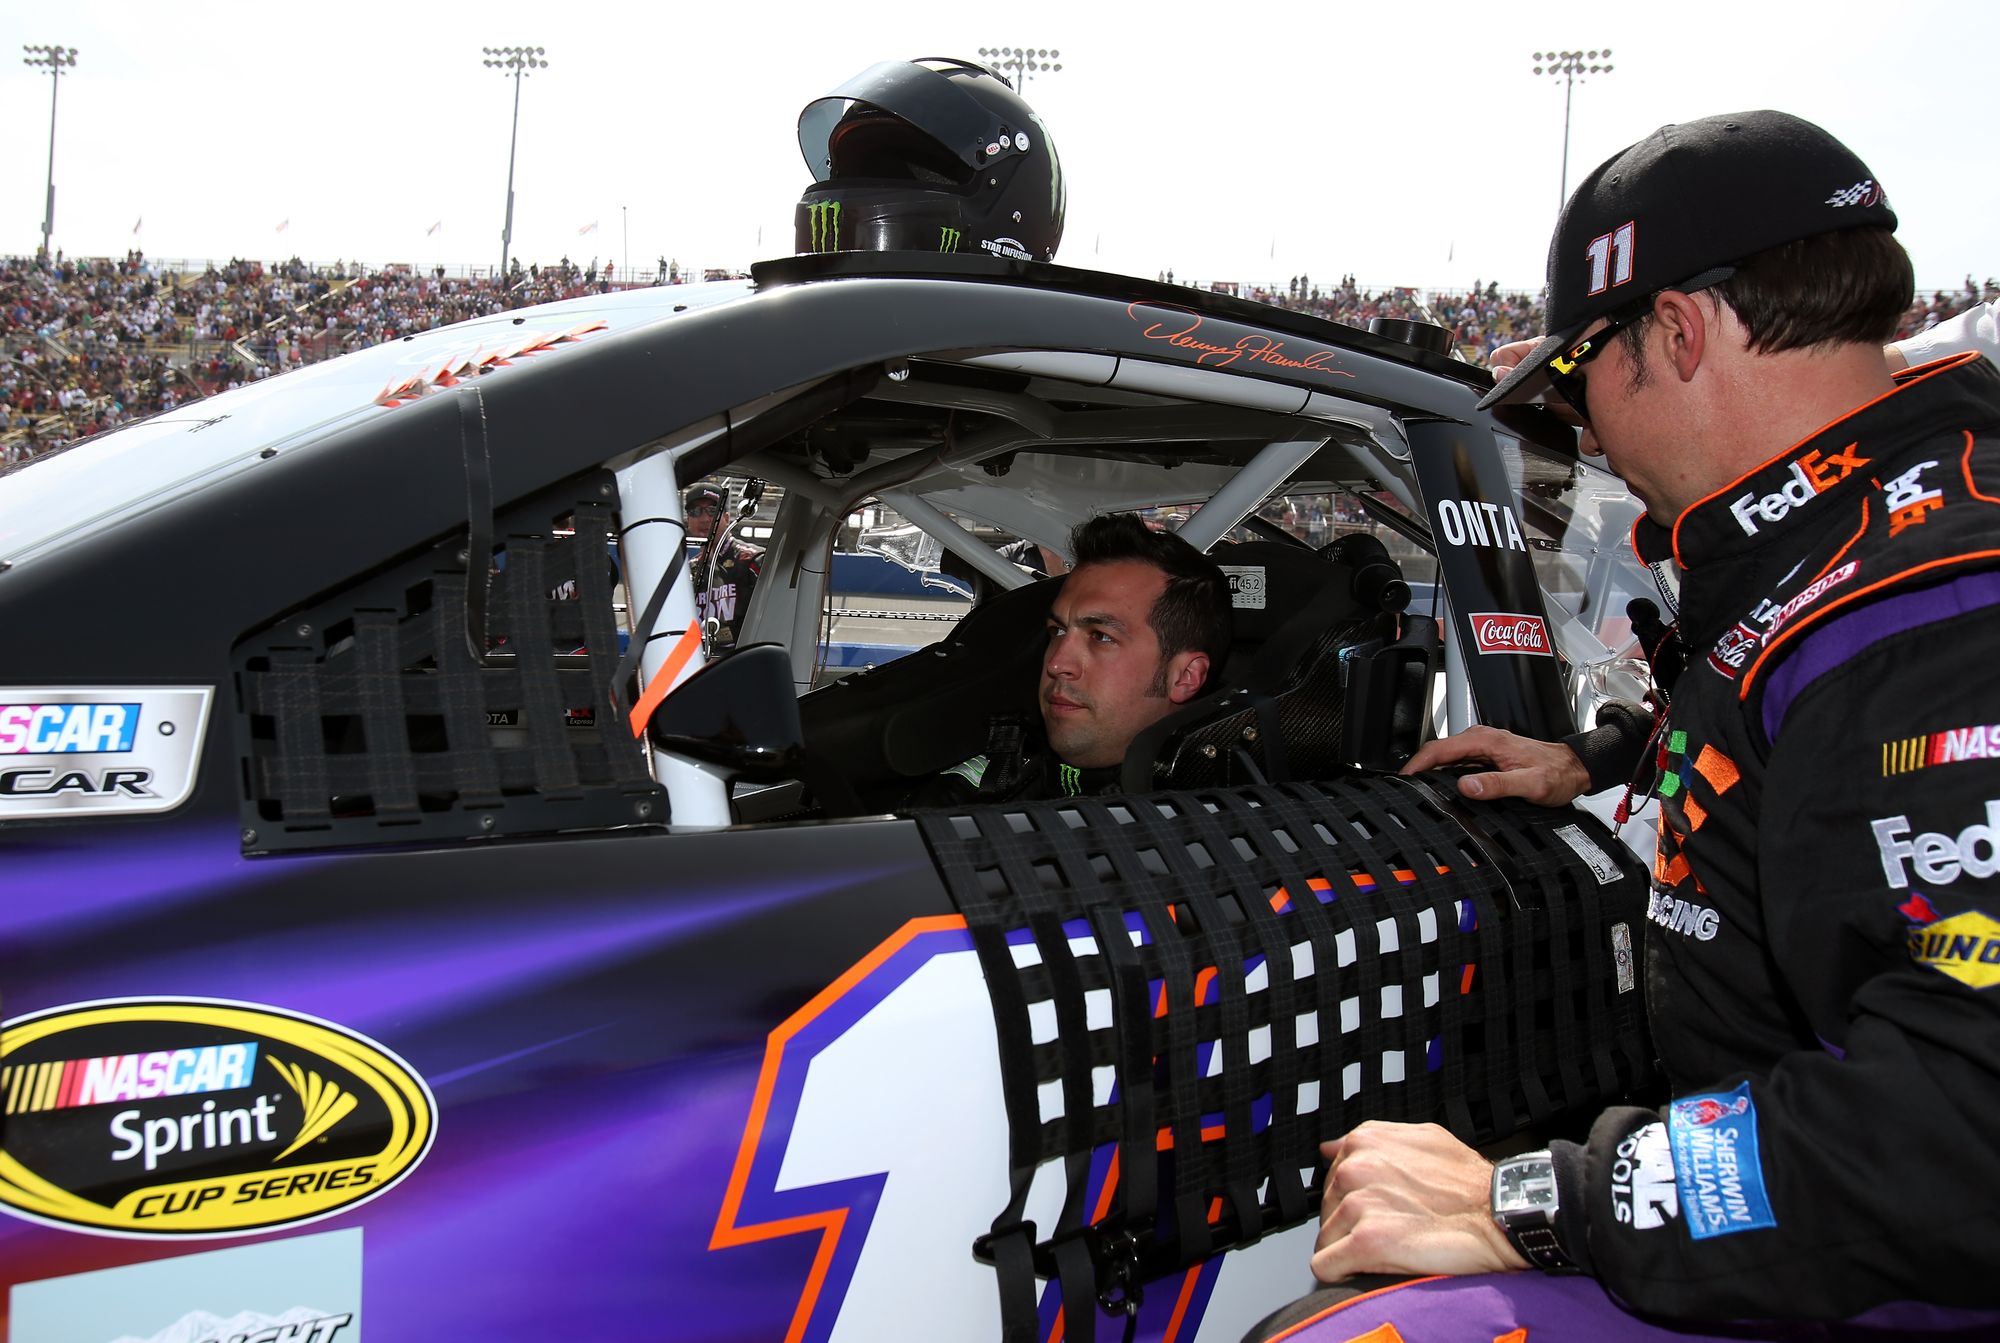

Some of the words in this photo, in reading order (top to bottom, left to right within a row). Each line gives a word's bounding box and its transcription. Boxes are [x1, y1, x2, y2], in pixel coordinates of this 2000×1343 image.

[981, 240, 1001, 253] STAR
[1002, 246, 1033, 261] INFUSION
[1586, 221, 1634, 296] 11
[1730, 442, 1872, 537] FedEx
[1438, 499, 1526, 552] ONTA
[1239, 578, 1261, 590] 45.2
[1480, 618, 1545, 648] Coca-Cola
[79, 1044, 249, 1106] NASCAR
[110, 1095, 277, 1171] Sprint
[132, 1185, 226, 1220] CUP
[231, 1163, 379, 1205] SERIES
[1689, 1127, 1729, 1228] WILLIAMS
[1714, 1127, 1752, 1223] SHERWIN
